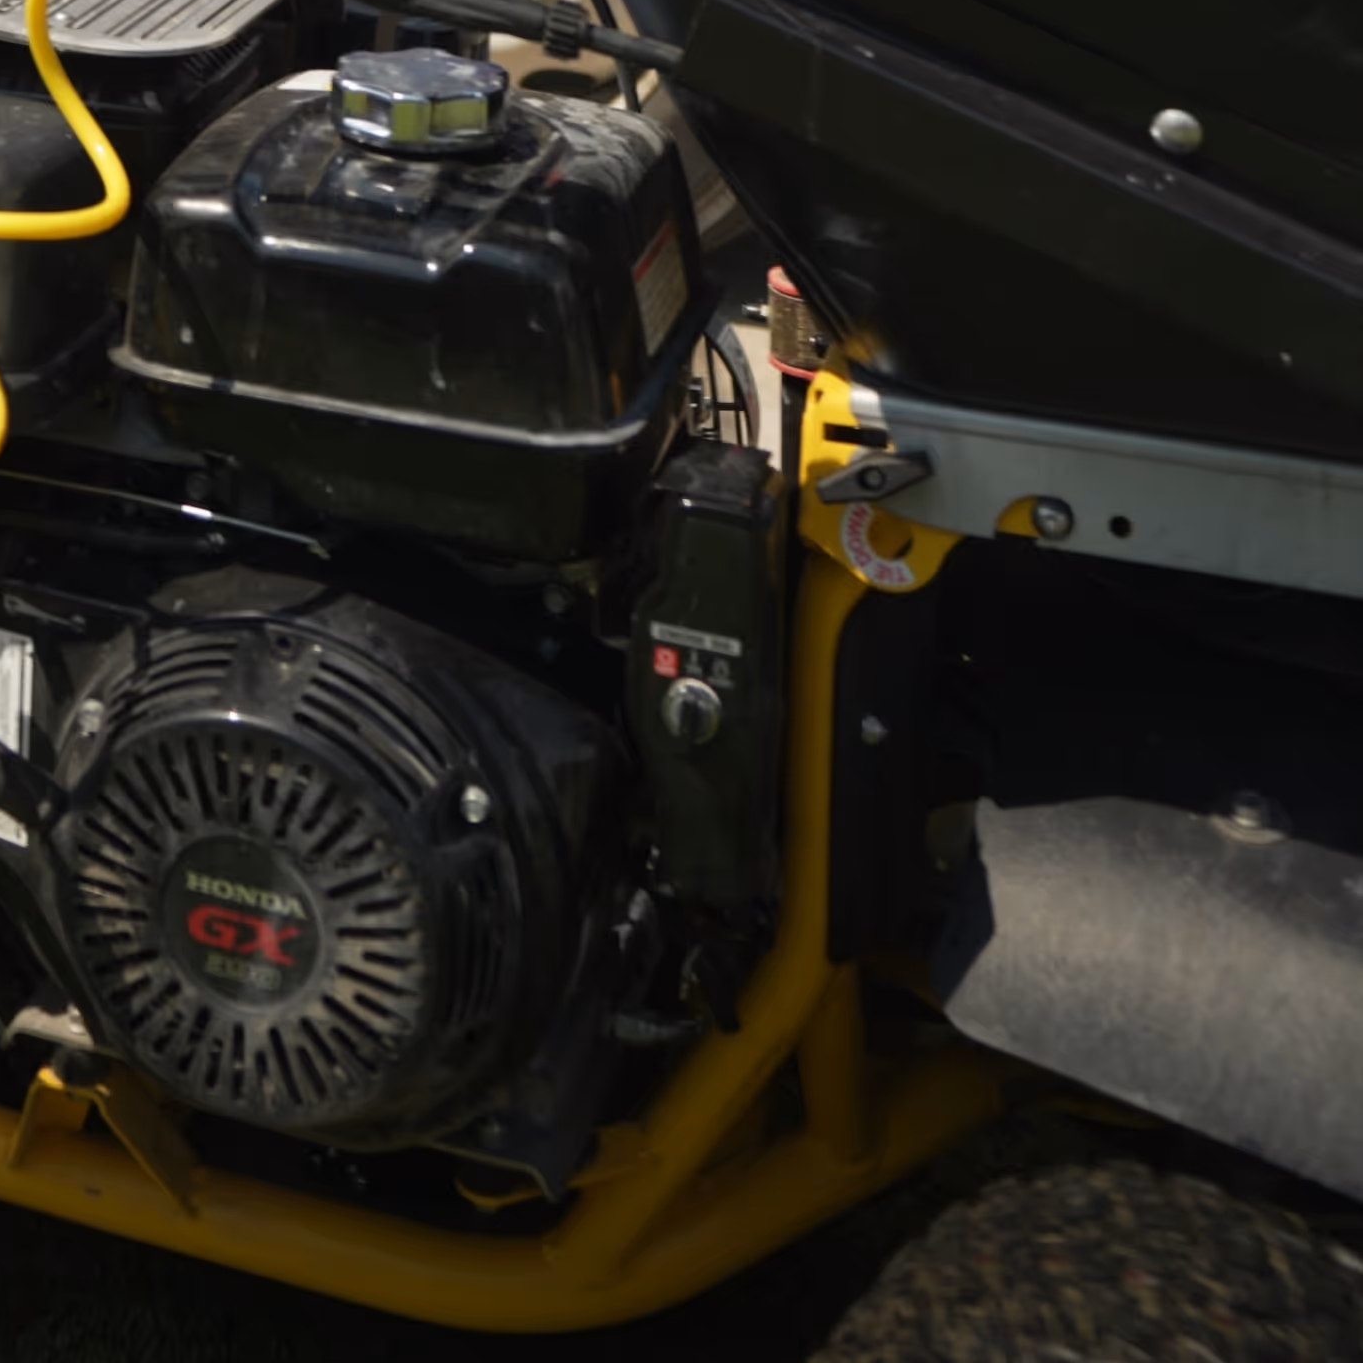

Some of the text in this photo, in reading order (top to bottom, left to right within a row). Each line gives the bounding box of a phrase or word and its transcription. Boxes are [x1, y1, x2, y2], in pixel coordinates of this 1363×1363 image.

[846, 506, 909, 583] TIE DOWN
[185, 870, 307, 919] HONDA
[187, 904, 301, 967] GX
